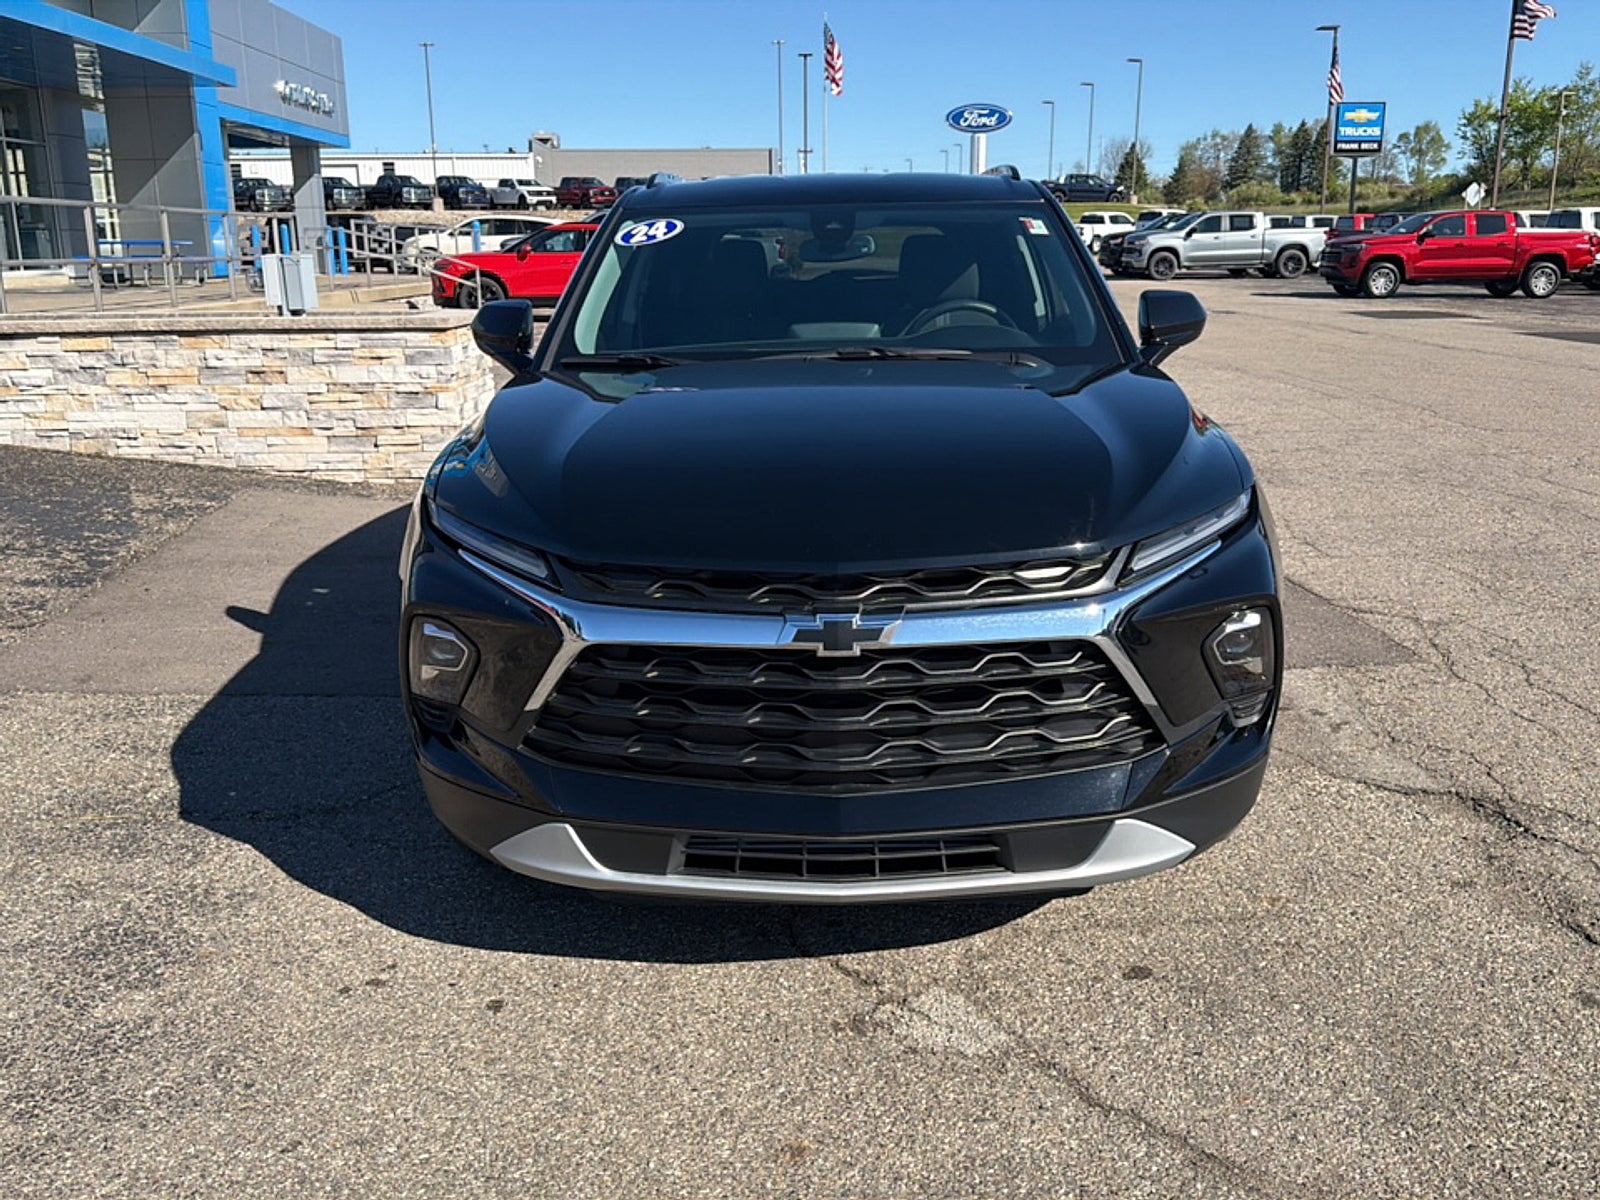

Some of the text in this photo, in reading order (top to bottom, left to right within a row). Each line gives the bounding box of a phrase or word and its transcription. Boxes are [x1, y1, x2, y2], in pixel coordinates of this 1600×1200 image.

[960, 109, 1000, 127] Ford
[1338, 126, 1381, 137] TRUCKS
[1336, 142, 1359, 150] FRANK
[629, 221, 668, 243] 24
